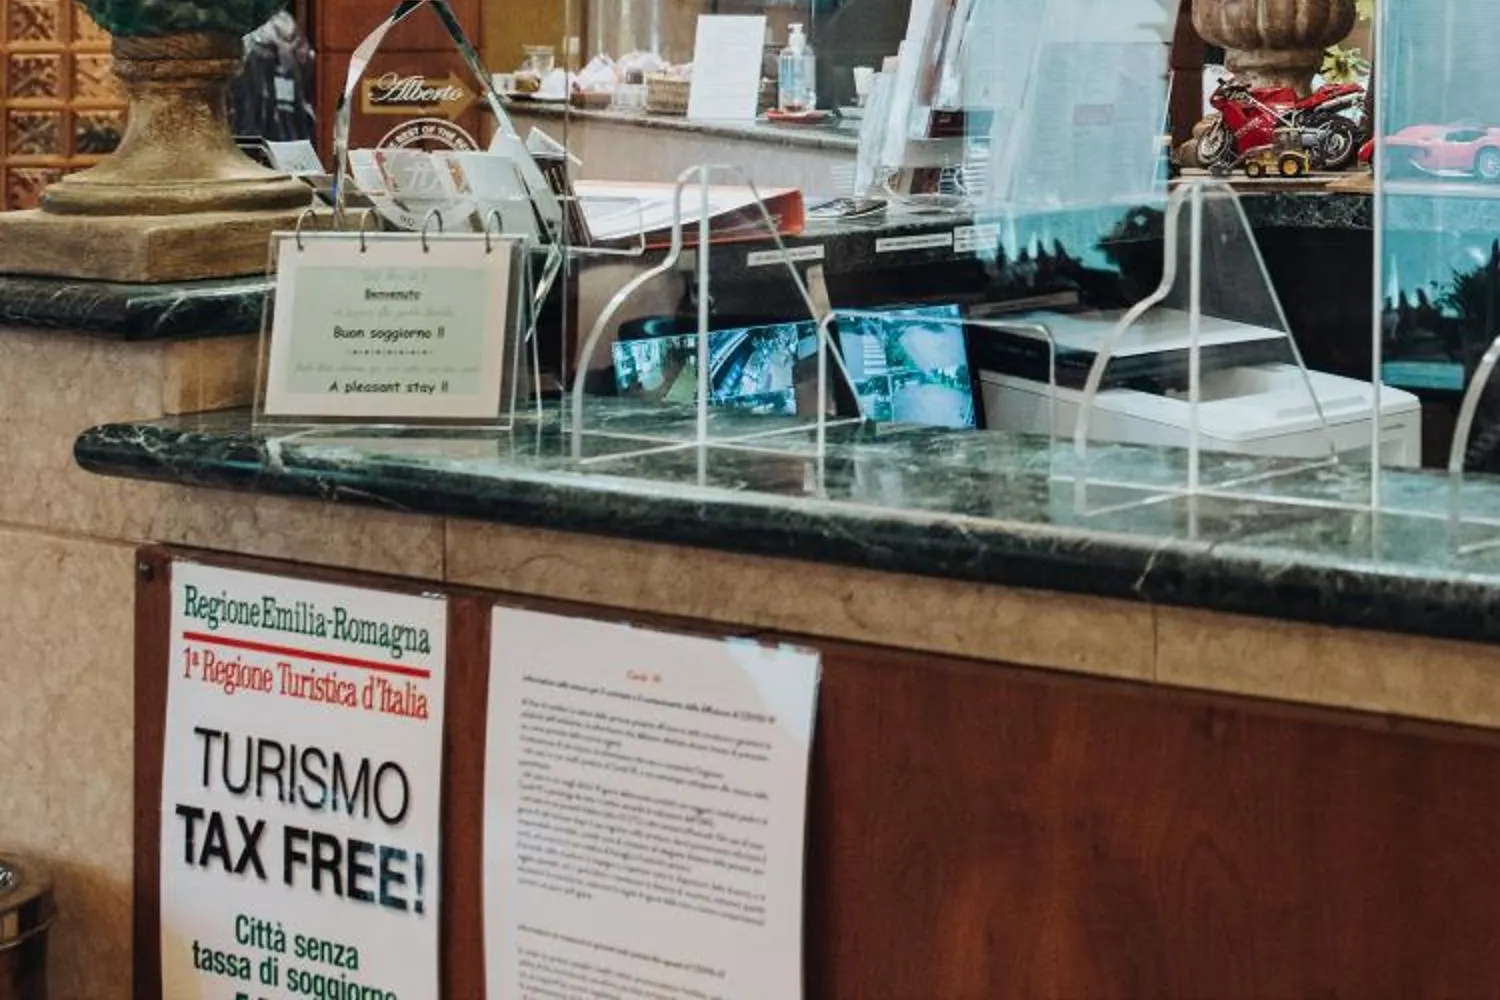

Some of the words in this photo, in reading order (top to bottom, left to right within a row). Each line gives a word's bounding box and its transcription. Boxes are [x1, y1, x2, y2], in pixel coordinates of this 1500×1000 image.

[368, 72, 464, 101] Alberto
[333, 325, 365, 339] Buon
[370, 327, 432, 342] soggiorno
[328, 381, 339, 392] A
[344, 380, 401, 394] pleasant
[406, 382, 436, 395] stay
[203, 650, 273, 694] Regione
[277, 662, 357, 707] Turistica
[362, 676, 429, 719] d'Italia
[194, 727, 410, 826] TURISMO
[175, 804, 268, 881] TAX
[283, 825, 426, 914] FREE!
[192, 940, 251, 980] tassa
[260, 956, 279, 987] di
[235, 914, 286, 953] Città
[294, 935, 359, 970] senza
